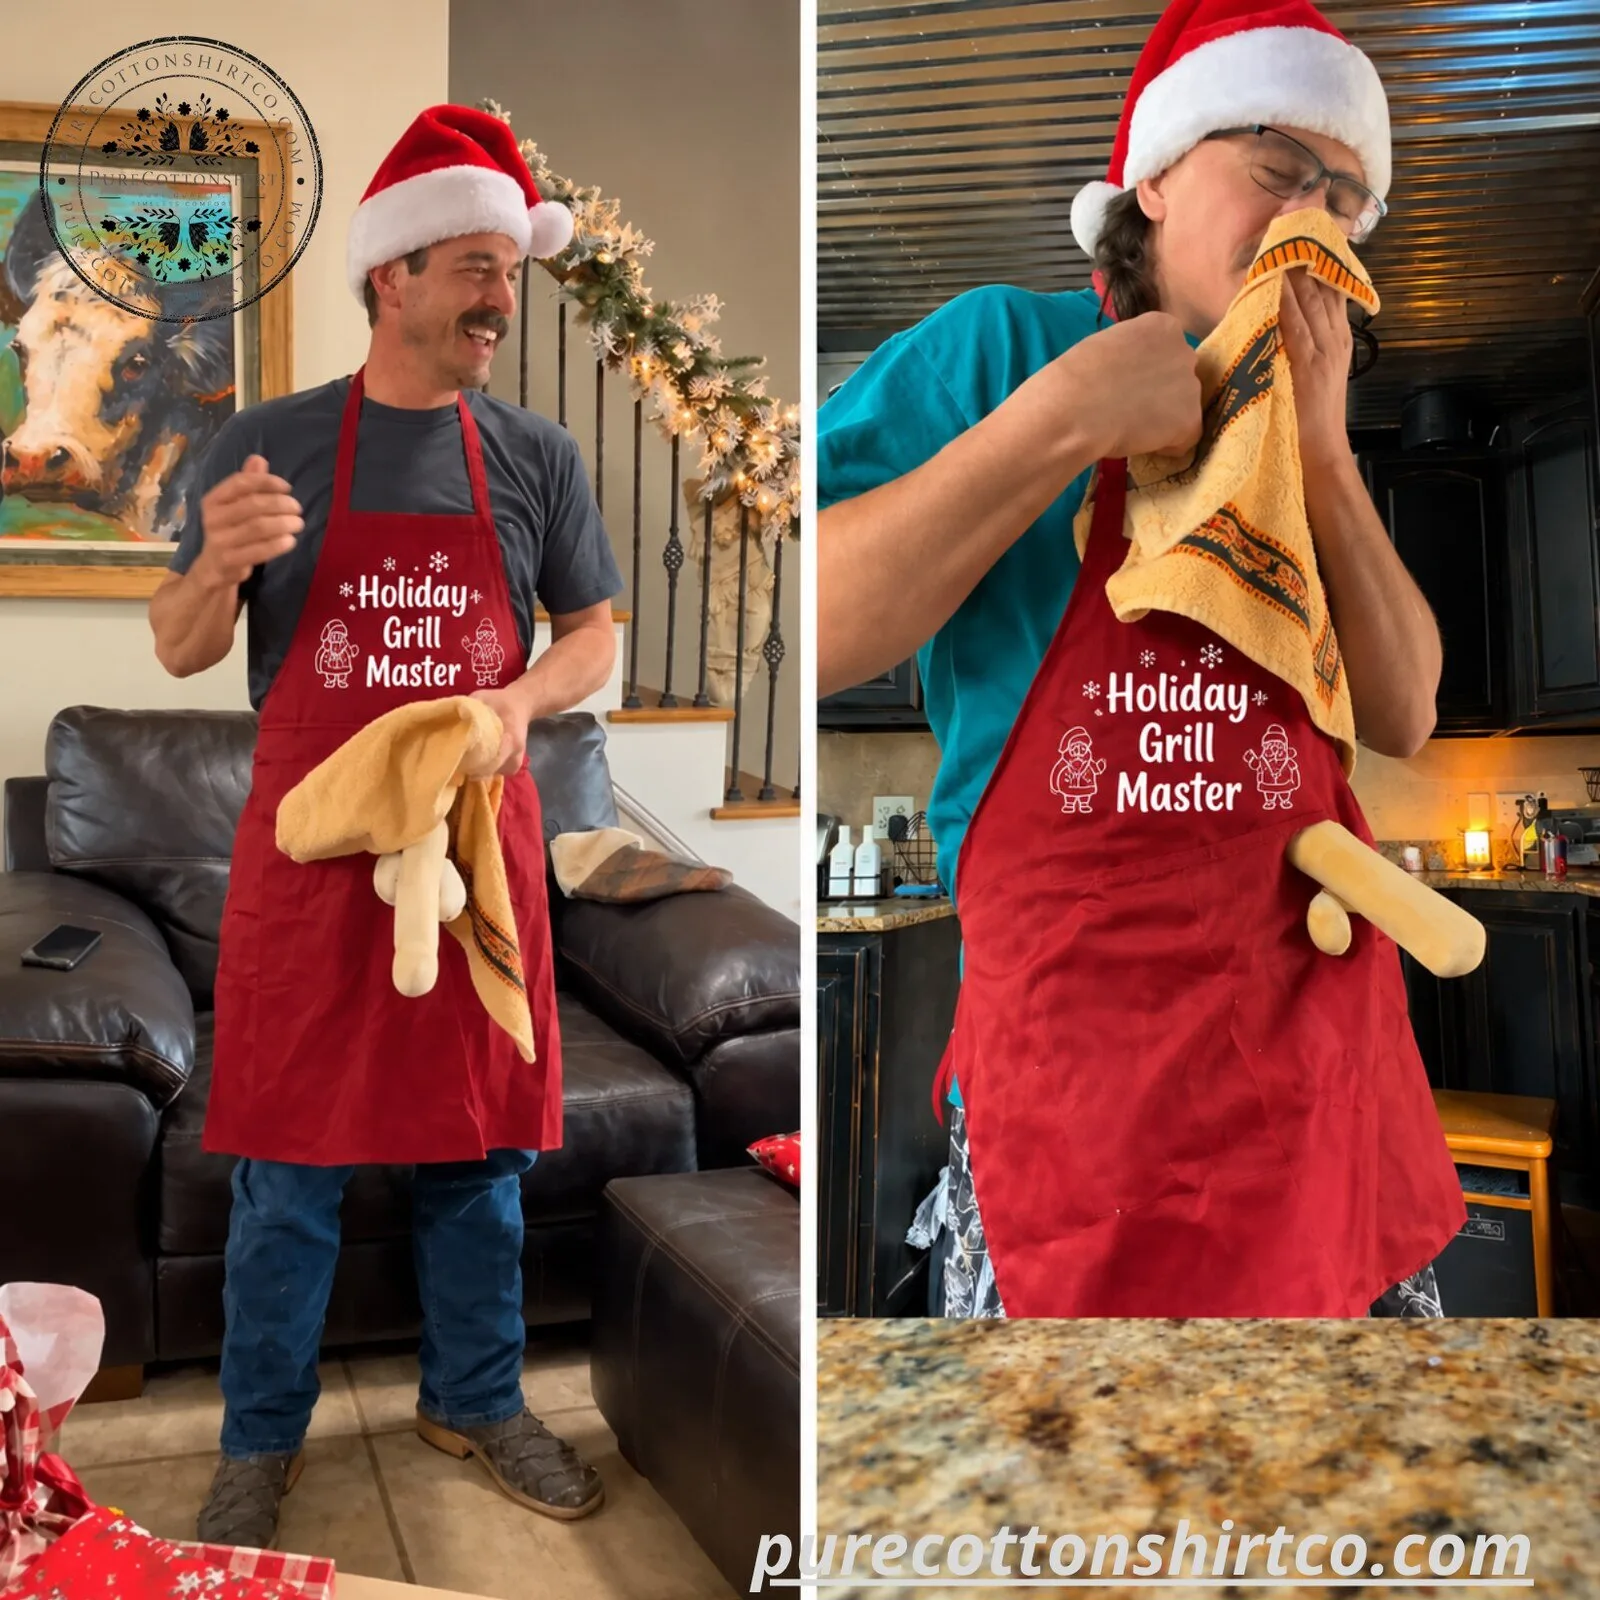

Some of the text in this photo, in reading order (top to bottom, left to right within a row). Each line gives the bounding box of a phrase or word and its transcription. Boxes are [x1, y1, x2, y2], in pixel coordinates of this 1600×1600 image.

[357, 574, 468, 618] Holiday
[383, 615, 441, 649] Grill
[366, 654, 462, 688] Master
[1106, 671, 1248, 724] Holiday
[1139, 721, 1215, 764] Grill
[1116, 770, 1243, 813] Master
